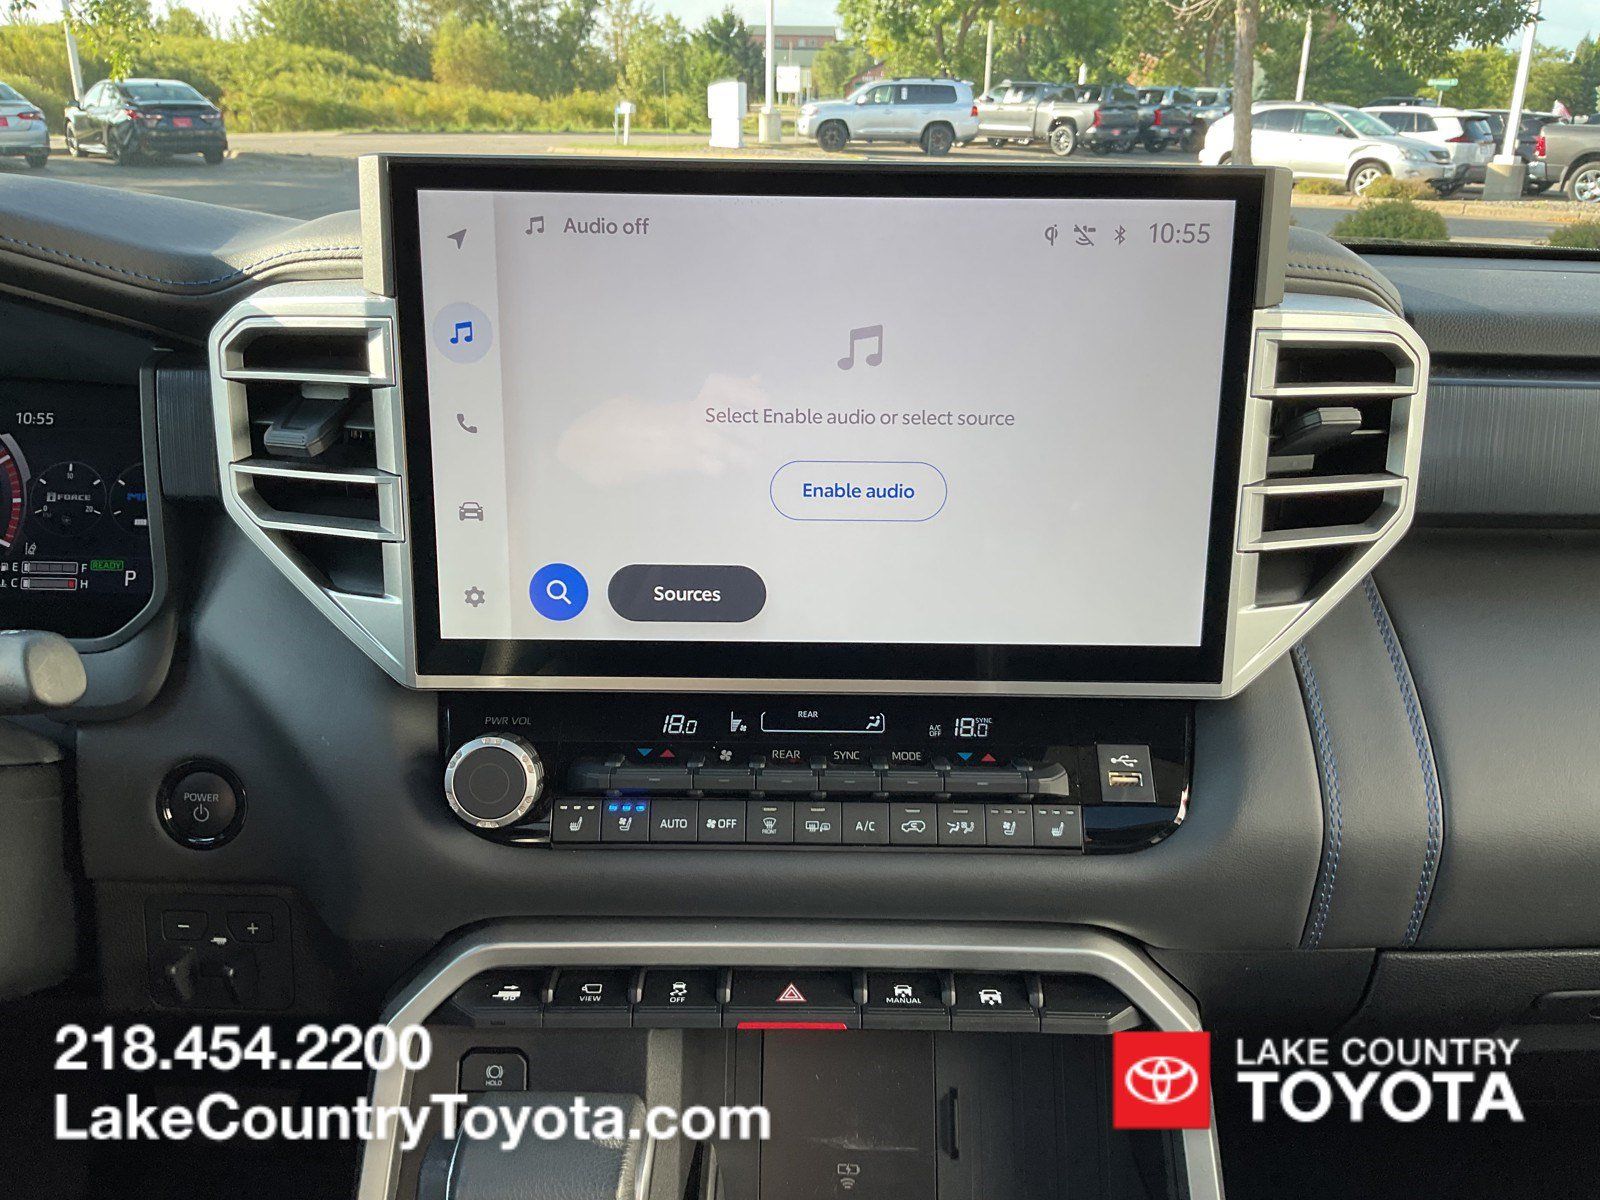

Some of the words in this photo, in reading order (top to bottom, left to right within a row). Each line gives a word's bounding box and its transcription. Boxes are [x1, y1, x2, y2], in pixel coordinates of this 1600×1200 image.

[564, 217, 617, 234] Audio
[622, 217, 650, 234] off
[1150, 223, 1211, 244] 10:55
[16, 411, 54, 425] 10:55
[706, 408, 758, 424] Select
[764, 408, 822, 424] Enable
[827, 409, 875, 425] audio
[880, 413, 899, 425] or
[903, 410, 954, 426] select
[958, 414, 1015, 426] source
[803, 482, 861, 499] Enable
[866, 483, 915, 499] audio
[12, 562, 19, 572] E
[81, 563, 88, 573] F
[92, 561, 121, 570] READY
[10, 578, 18, 588] C
[80, 579, 89, 589] H
[124, 570, 137, 587] P
[653, 585, 721, 602] Sources
[797, 710, 819, 718] REAR
[484, 716, 508, 725] PWR
[511, 716, 532, 725] VOL
[662, 714, 698, 734] 18.0
[954, 717, 988, 737] 18.0
[772, 749, 801, 759] REAR
[833, 750, 860, 760] SYNC
[891, 751, 922, 761] MODE
[183, 792, 219, 803] POWER
[659, 818, 688, 829] AUTO
[717, 818, 737, 829] OFF
[855, 820, 875, 832] A/C
[885, 996, 922, 1004] MANUAL
[485, 1079, 503, 1087] HOLD
